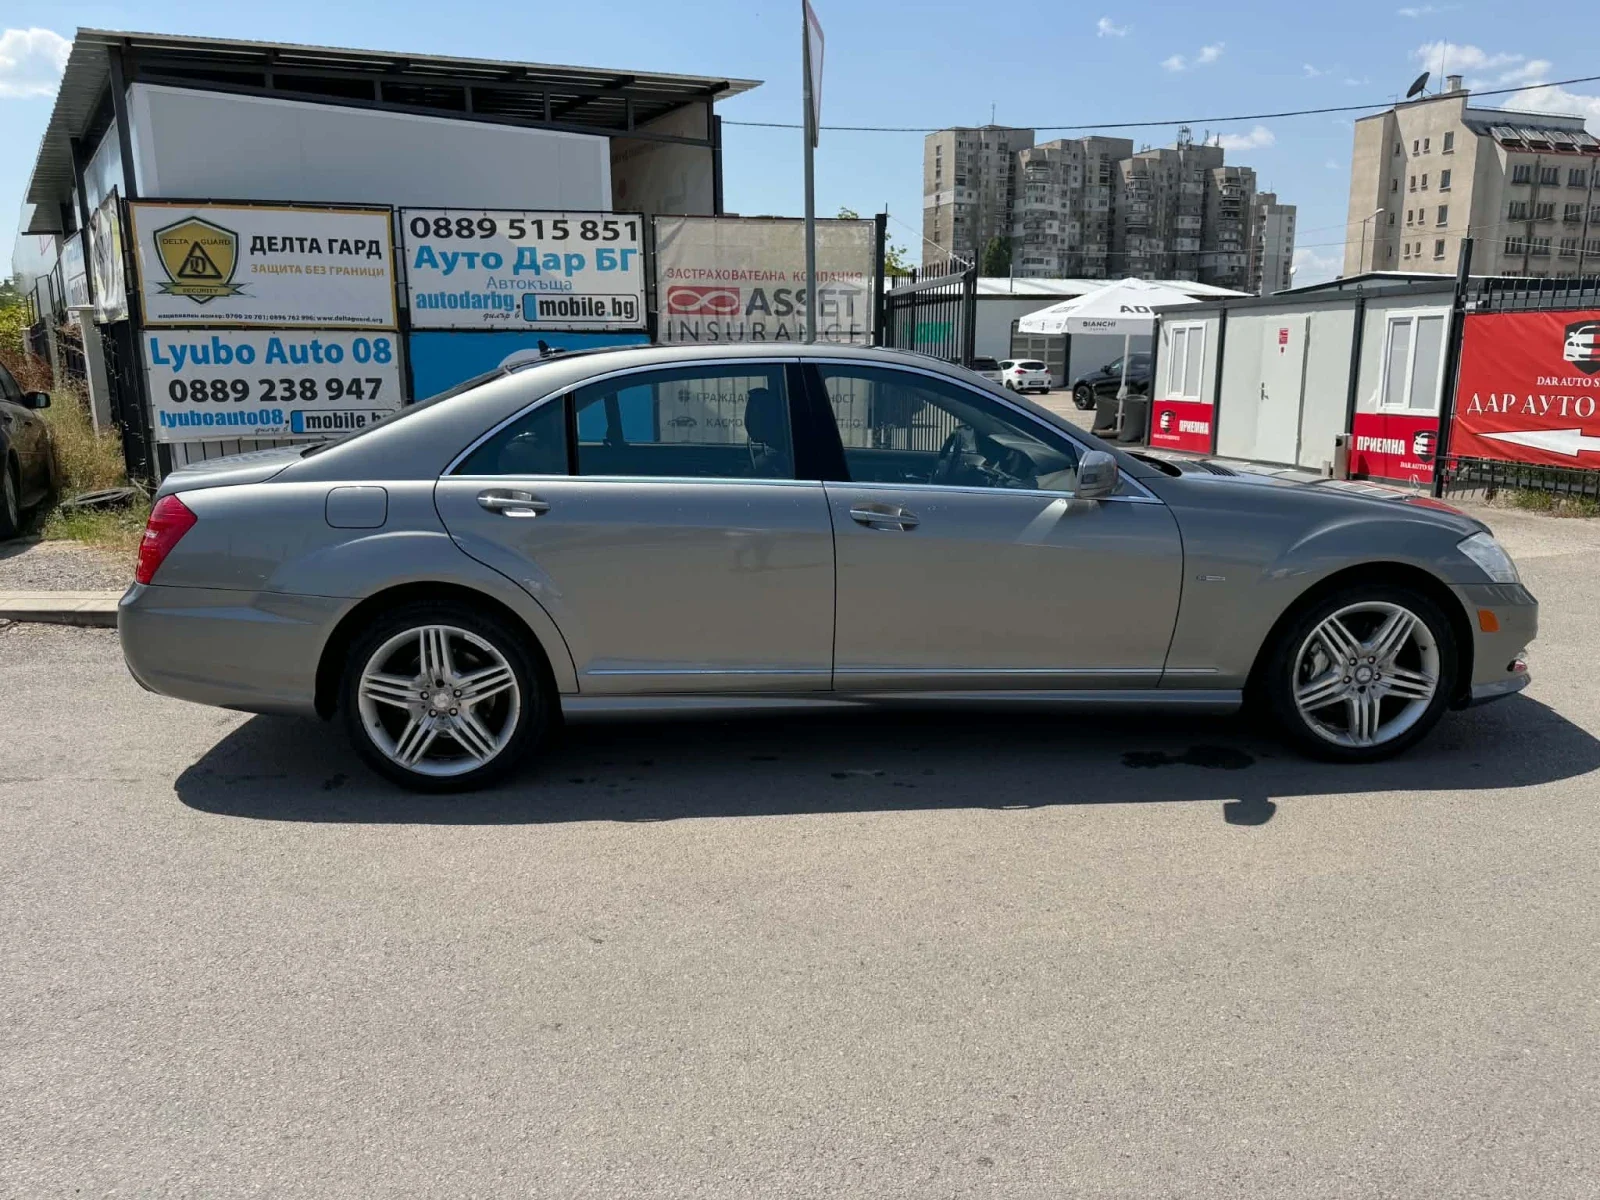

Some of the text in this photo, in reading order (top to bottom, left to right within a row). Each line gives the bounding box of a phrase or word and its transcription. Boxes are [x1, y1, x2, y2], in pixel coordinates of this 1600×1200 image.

[410, 217, 637, 241] 0889 515 851
[250, 236, 382, 259] ДЕЛТА ГАРД
[251, 264, 385, 278] ЗАЩИТА БЕЗ ГРАНИЦИ
[414, 246, 637, 277] Ауто Дар БГ
[486, 276, 572, 292] Автокъща
[667, 269, 863, 282] ЗАСТРАХОВАТЕЛНА КОПАНИЯ
[539, 297, 634, 319] mobile.bg
[151, 336, 392, 373] Lyubo Auto 08
[169, 378, 383, 402] 0889 238 947
[1537, 376, 1559, 386] DAR
[1560, 378, 1591, 387] AUTO
[1467, 393, 1595, 418] ДАР АУТО
[1357, 436, 1405, 455] ПРИЕМНА
